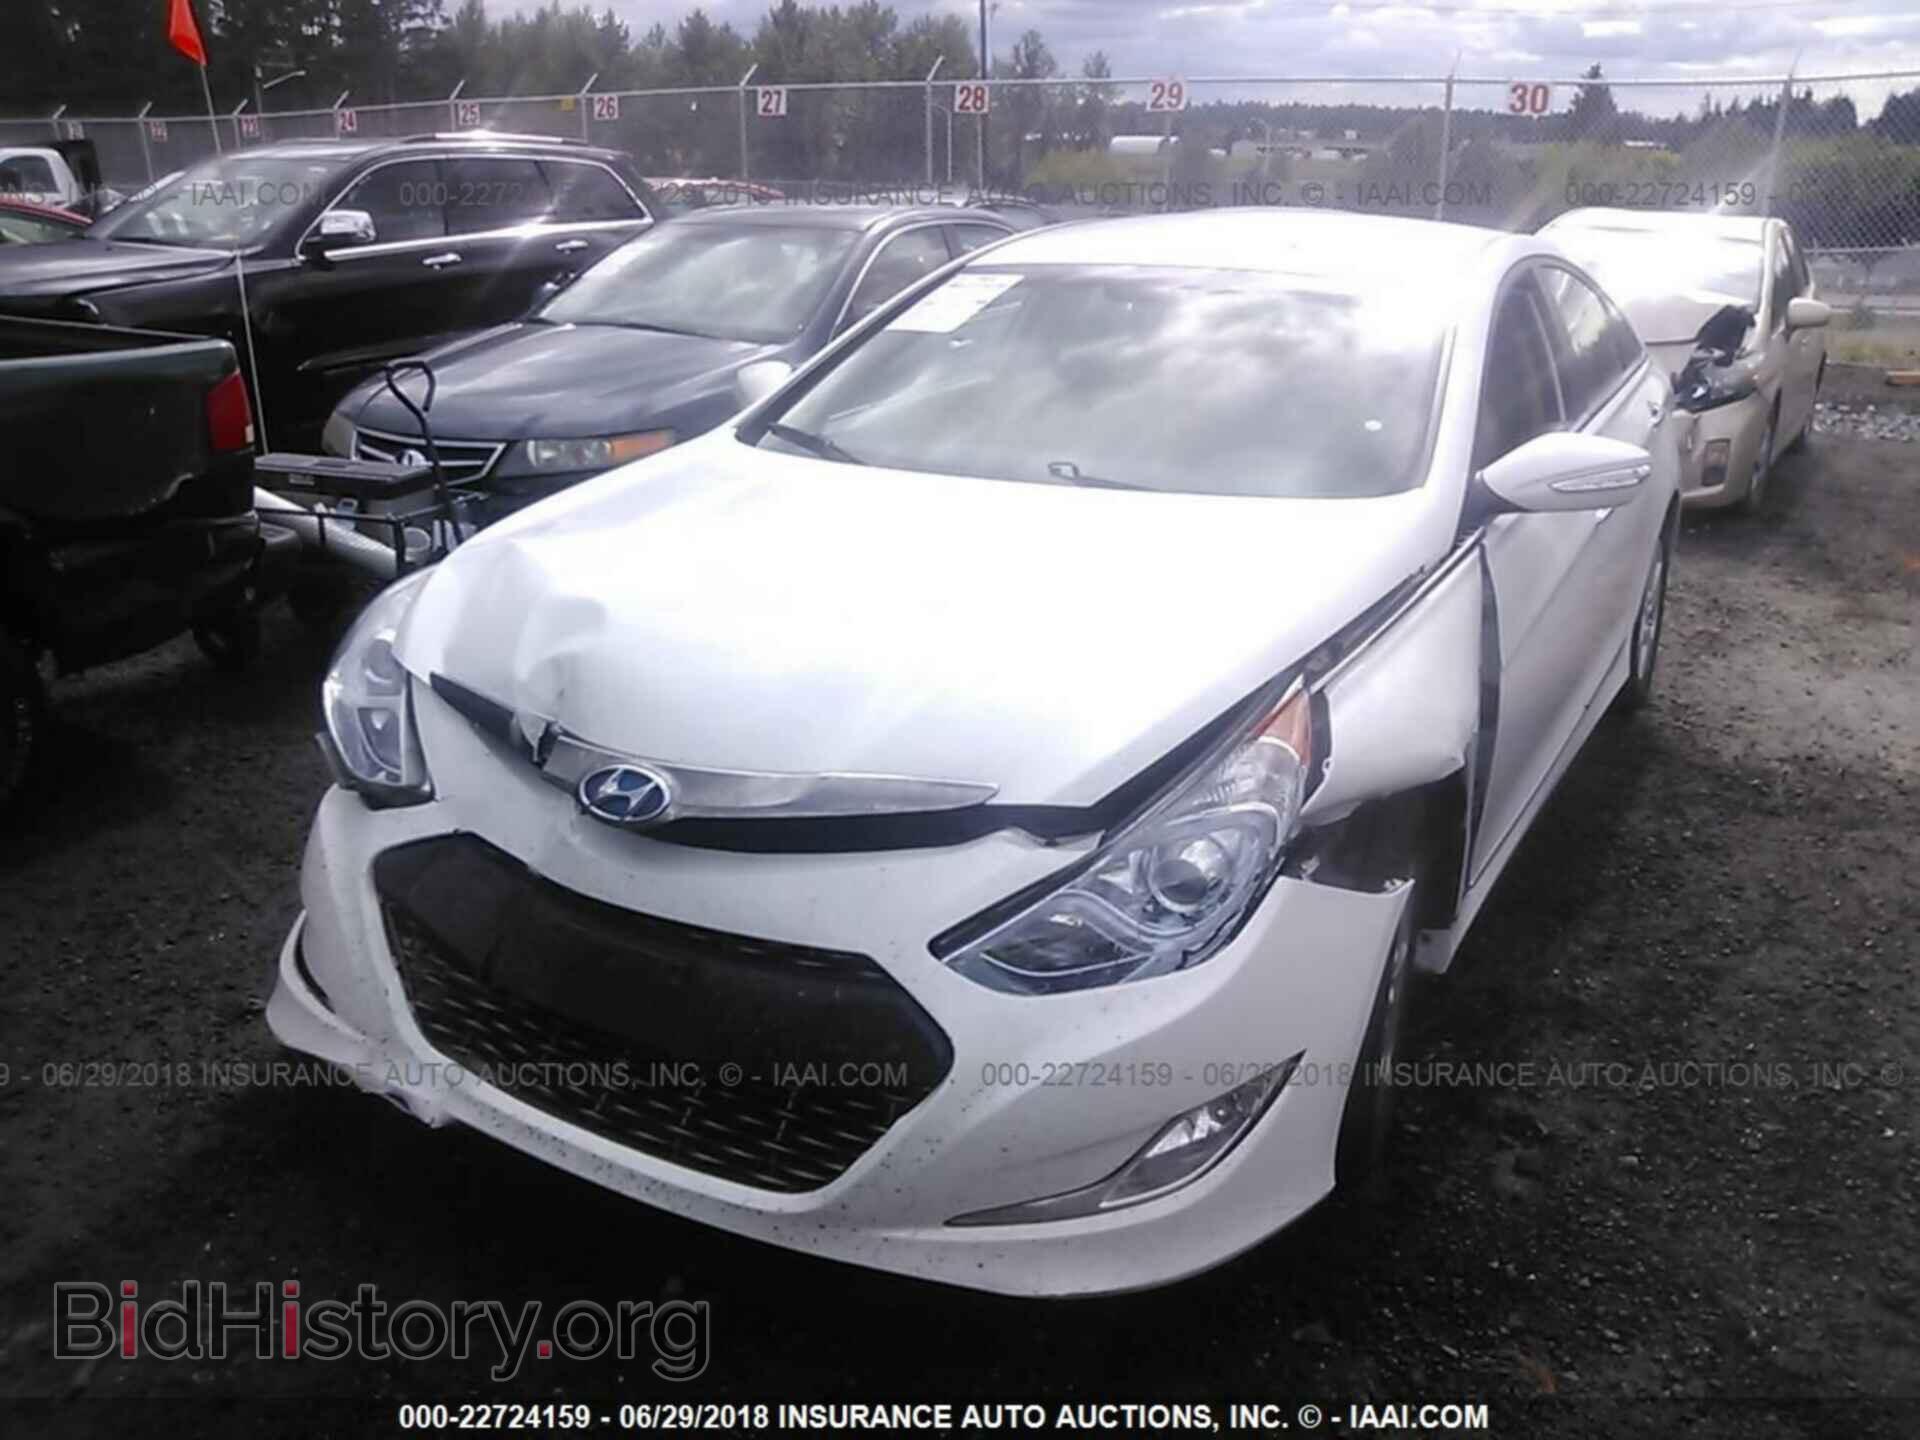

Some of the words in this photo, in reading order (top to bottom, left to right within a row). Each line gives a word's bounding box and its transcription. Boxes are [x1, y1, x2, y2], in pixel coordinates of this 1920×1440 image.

[761, 90, 783, 114] 27
[958, 86, 986, 111] 28
[1151, 81, 1183, 109] 29
[1509, 84, 1549, 113] 30
[461, 105, 479, 126] 25
[597, 98, 617, 118] 26
[339, 112, 356, 131] 24
